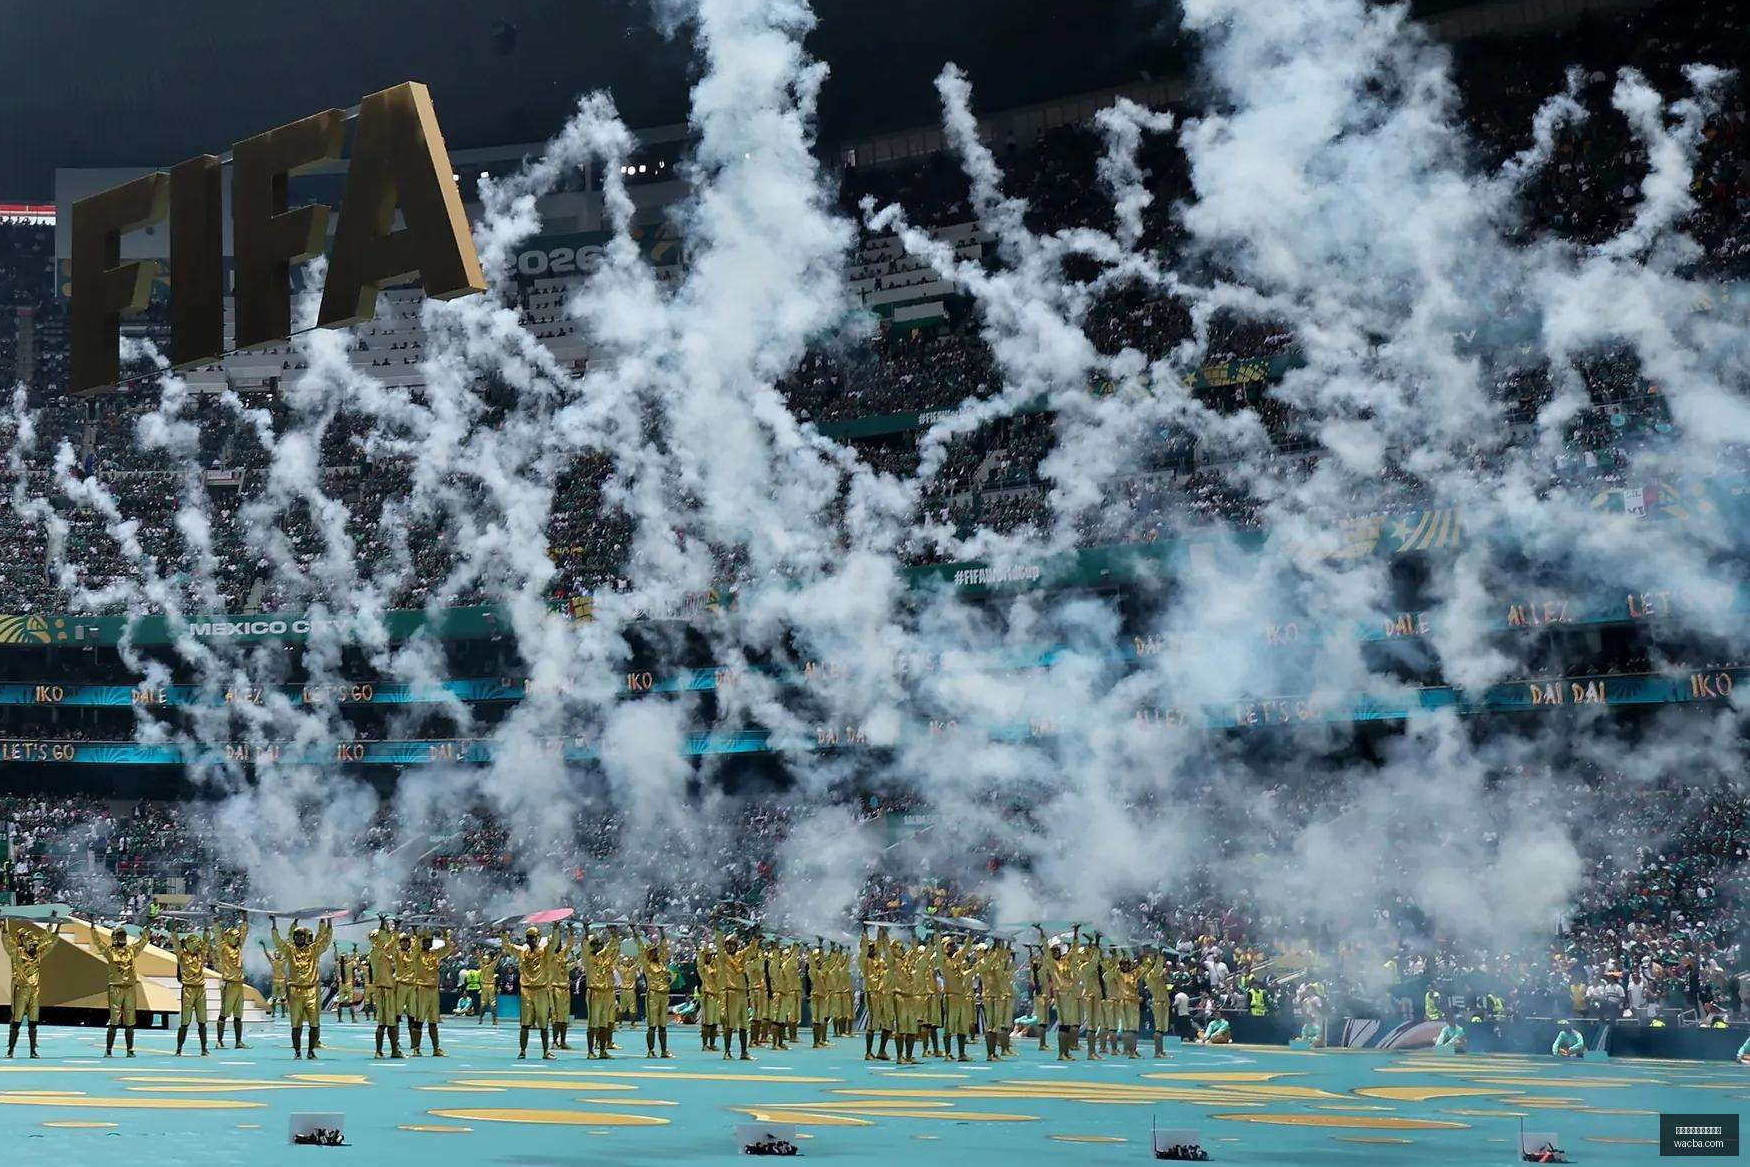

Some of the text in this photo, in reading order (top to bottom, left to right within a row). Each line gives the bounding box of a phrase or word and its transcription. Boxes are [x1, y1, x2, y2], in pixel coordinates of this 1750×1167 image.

[70, 81, 487, 398] FIFA
[1507, 600, 1573, 626] ALLEZ
[189, 620, 287, 635] MEXICO
[1385, 611, 1430, 636] DALE
[627, 672, 653, 691] IKO
[1691, 672, 1733, 698] IKO
[35, 685, 64, 702] IKO
[131, 687, 167, 704] DALE
[350, 685, 373, 702] GO
[1529, 681, 1607, 705] DAI DAI
[2, 742, 75, 761] LET'S GO
[225, 744, 250, 761] DAI
[337, 744, 365, 761] IKO
